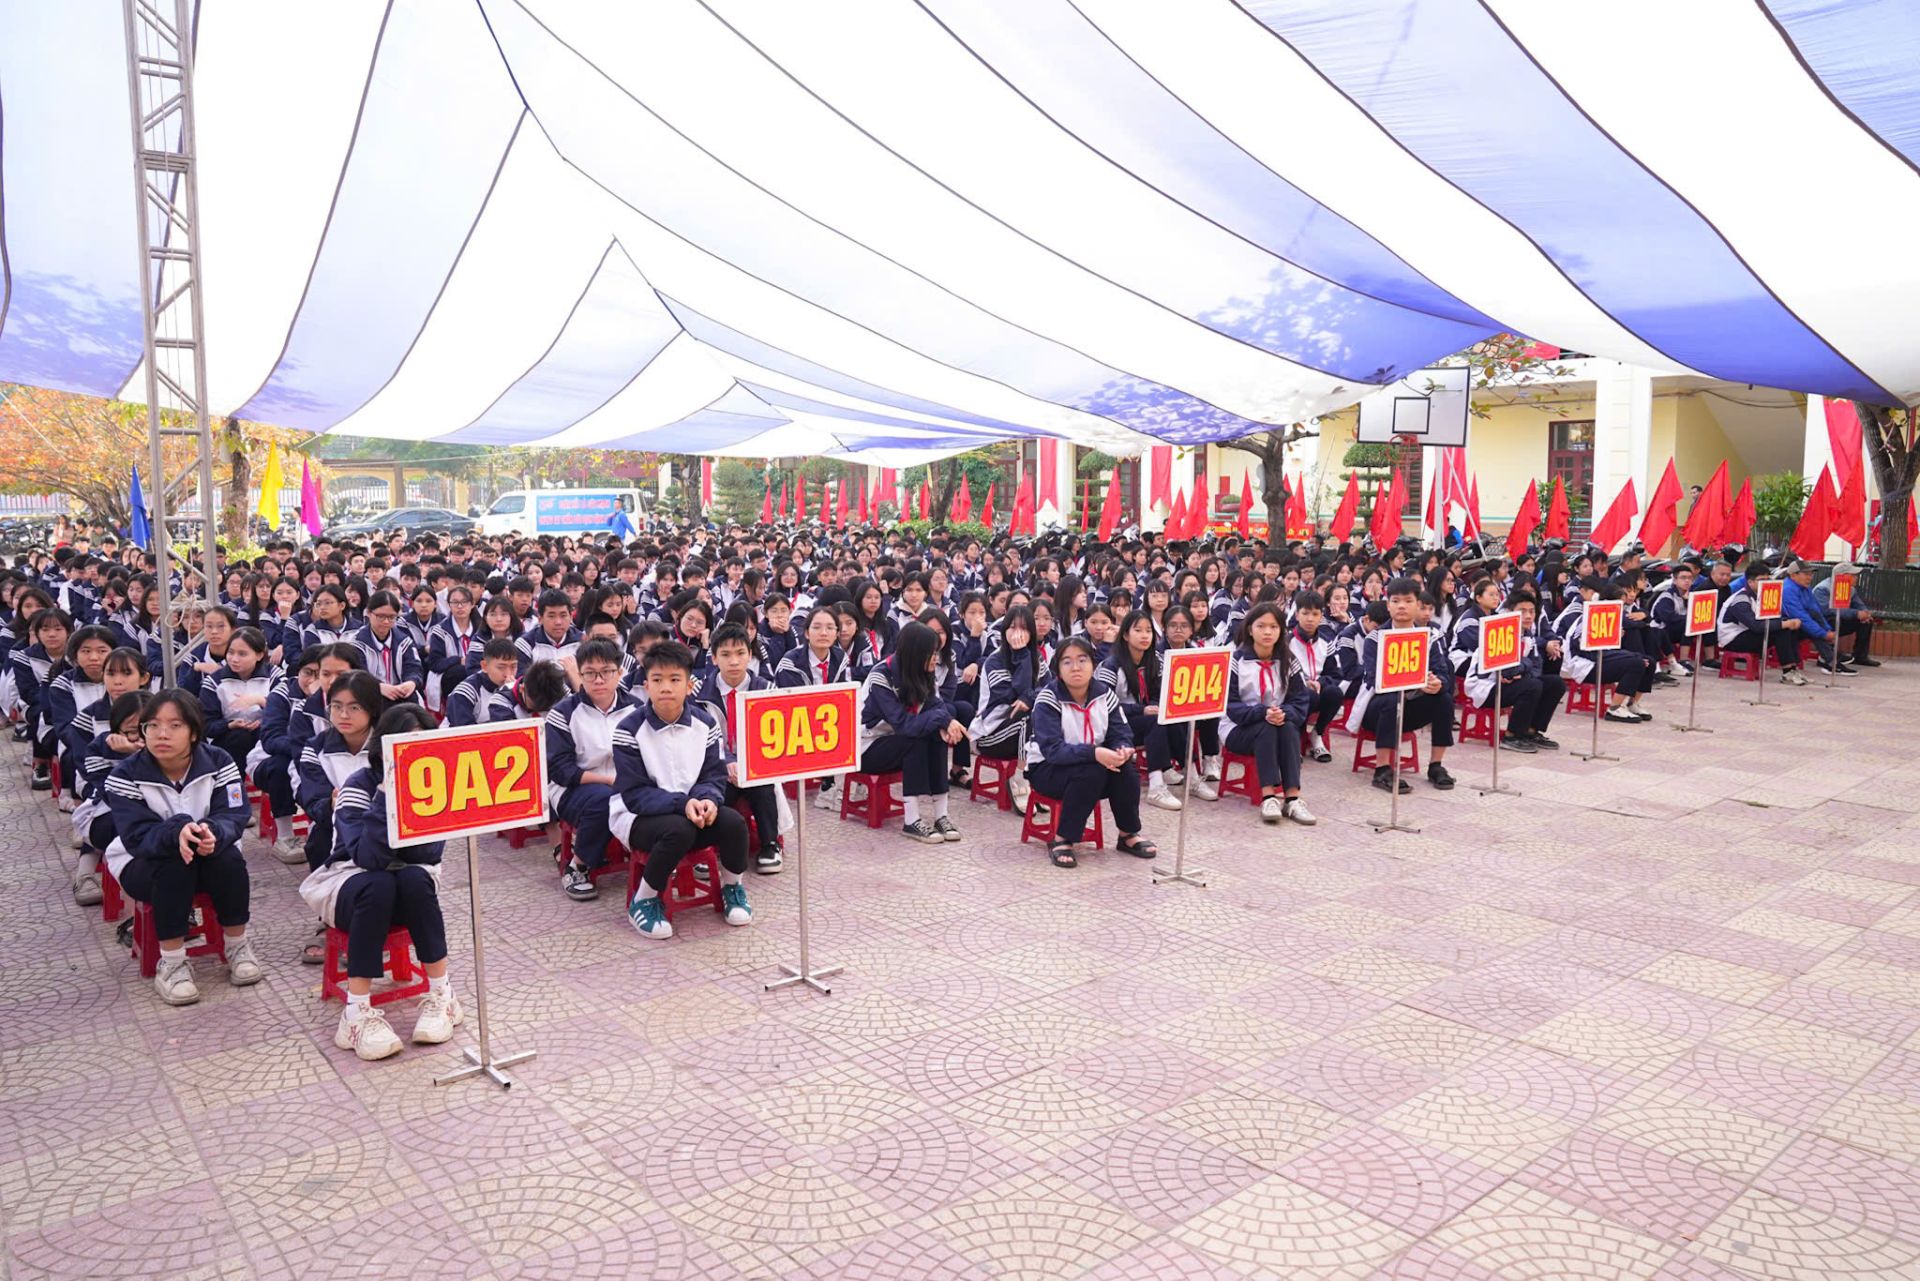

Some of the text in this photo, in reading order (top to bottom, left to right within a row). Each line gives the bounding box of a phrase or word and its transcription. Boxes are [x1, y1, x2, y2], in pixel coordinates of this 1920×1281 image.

[1694, 601, 1713, 624] 9A8
[1763, 590, 1779, 609] 9A9
[1592, 612, 1617, 638] 9A7
[1388, 641, 1421, 674] 9A5
[1488, 626, 1514, 657] 9A6
[1173, 666, 1222, 704] 9A4
[761, 704, 839, 758] 9A3
[409, 747, 529, 816] 9A2
